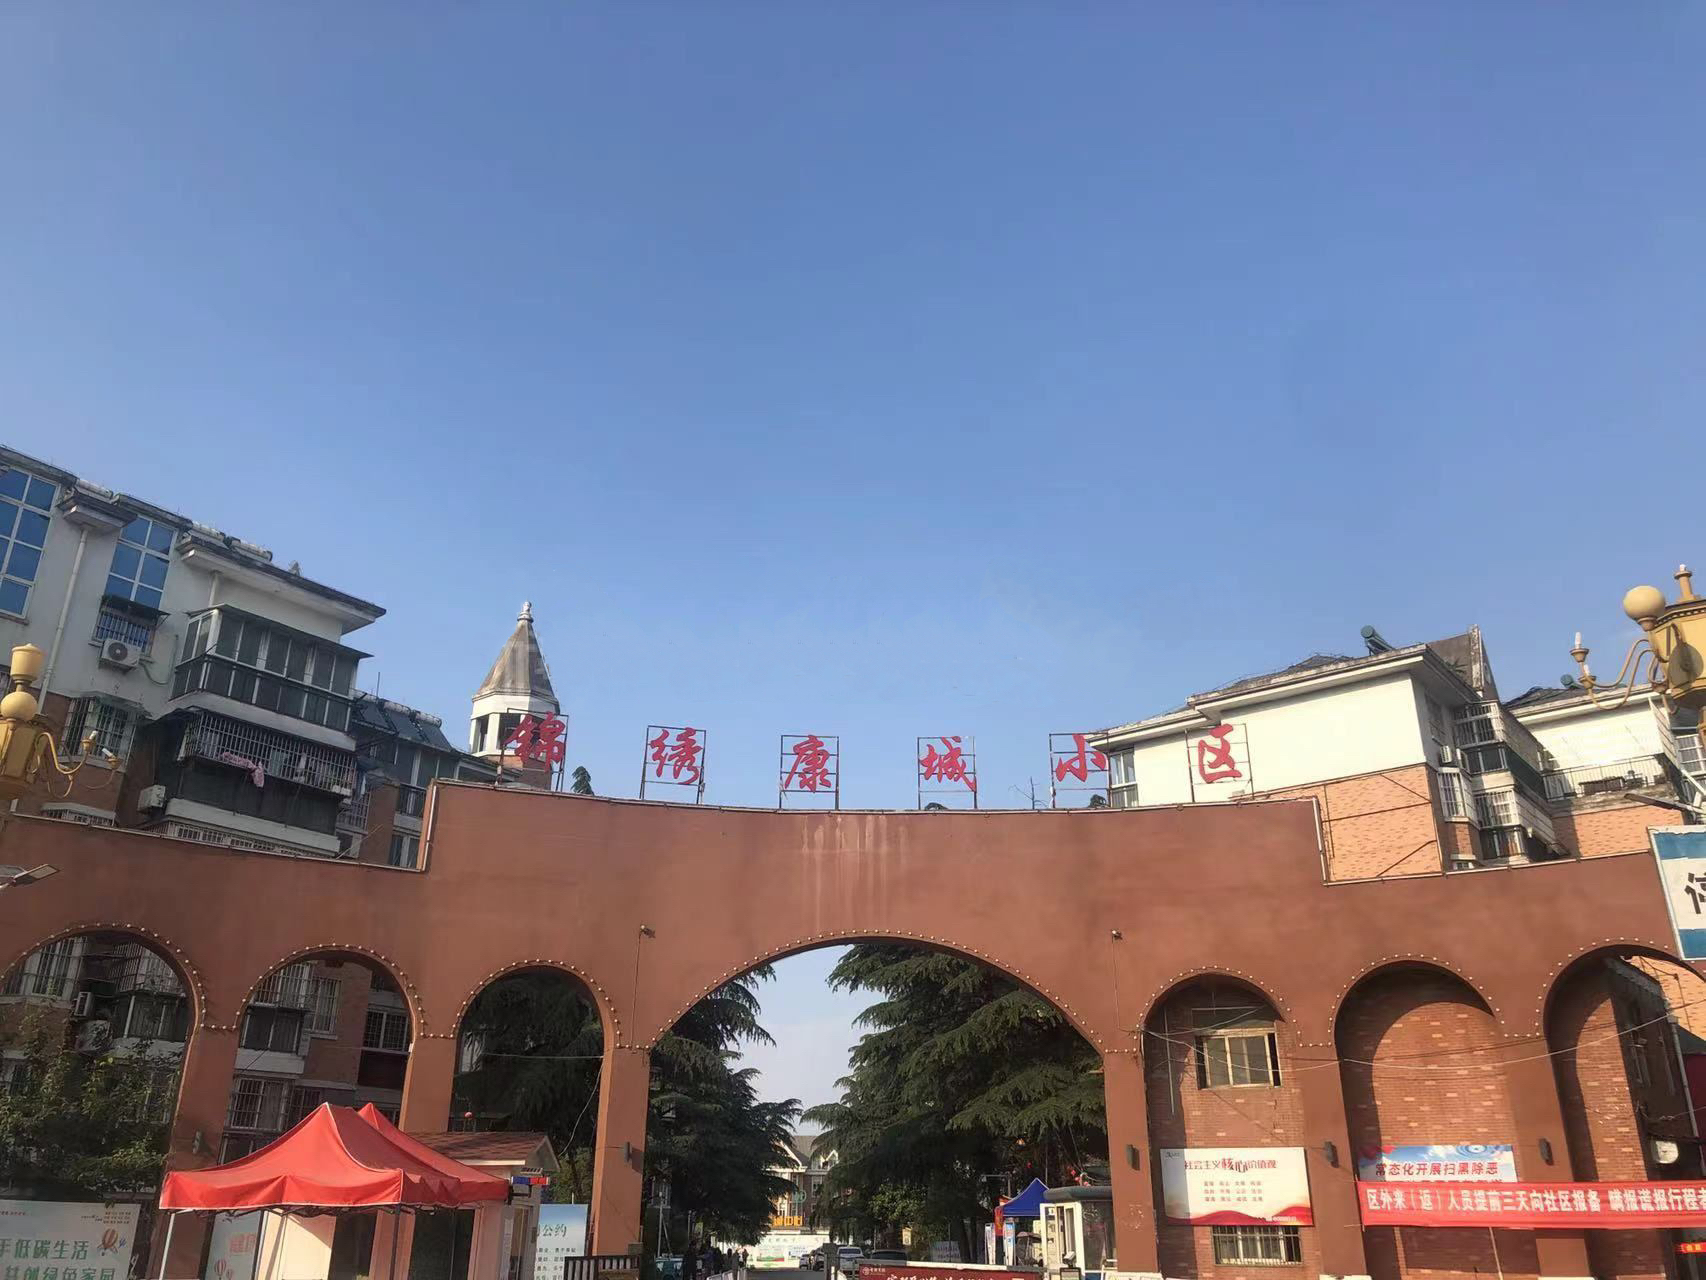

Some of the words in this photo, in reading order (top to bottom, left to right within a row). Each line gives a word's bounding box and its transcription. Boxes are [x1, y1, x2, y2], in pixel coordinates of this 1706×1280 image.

[502, 711, 1242, 793] 锦绣康城小区
[1376, 1162, 1498, 1177] 常态化开展扫黑除恶
[537, 1223, 567, 1237] 公约
